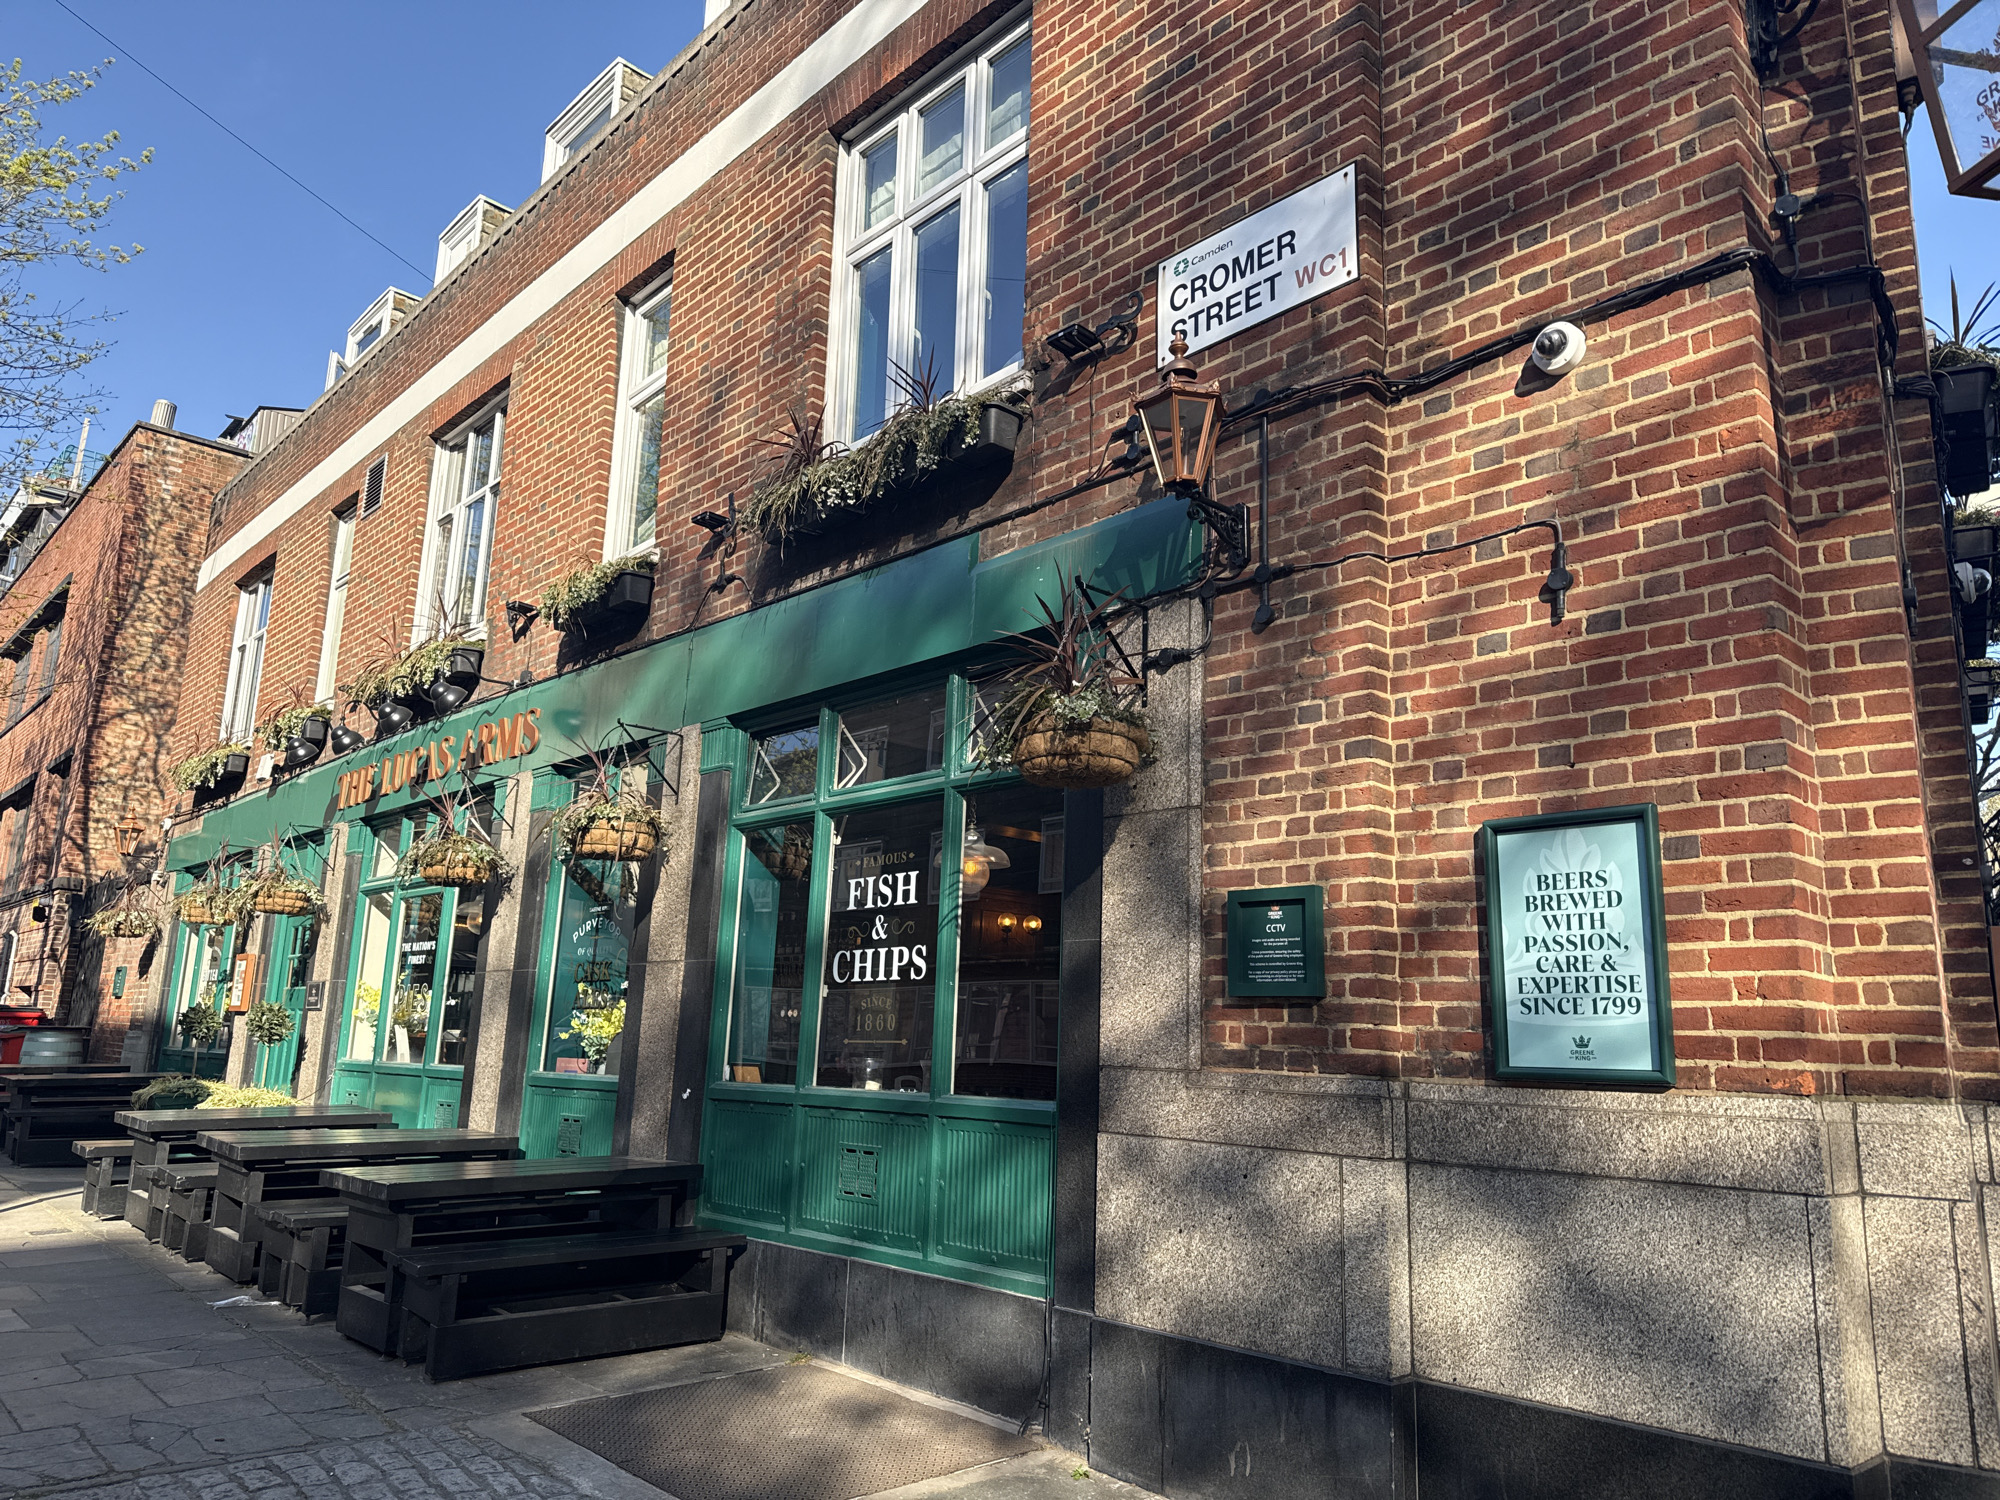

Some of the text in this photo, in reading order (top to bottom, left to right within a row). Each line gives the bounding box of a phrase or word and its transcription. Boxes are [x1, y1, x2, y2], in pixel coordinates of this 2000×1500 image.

[1191, 239, 1233, 266] Camden
[1169, 229, 1297, 312] CROMER
[1170, 246, 1348, 343] STREET WC1
[337, 707, 544, 810] THE LUCAS ARMS
[862, 851, 907, 869] FAMOUS
[846, 870, 920, 911] FISH
[1536, 869, 1608, 892] BEERS
[1525, 890, 1623, 913] BREWED
[572, 916, 622, 944] PURVEYOR
[871, 914, 888, 940] &
[1266, 923, 1286, 933] CCTV
[1542, 912, 1606, 931] WITH
[402, 942, 412, 952] THE
[577, 946, 587, 957] OF
[1524, 932, 1629, 954] PASSION,
[574, 959, 612, 983] CASK
[832, 944, 927, 984] CHIPS
[1536, 953, 1618, 974] CARE &
[1517, 974, 1643, 995] EXPERTISE
[397, 982, 429, 1013] PIES
[860, 996, 893, 1010] SINCE
[1520, 996, 1642, 1016] SINCE 1799
[855, 1013, 896, 1033] 1860
